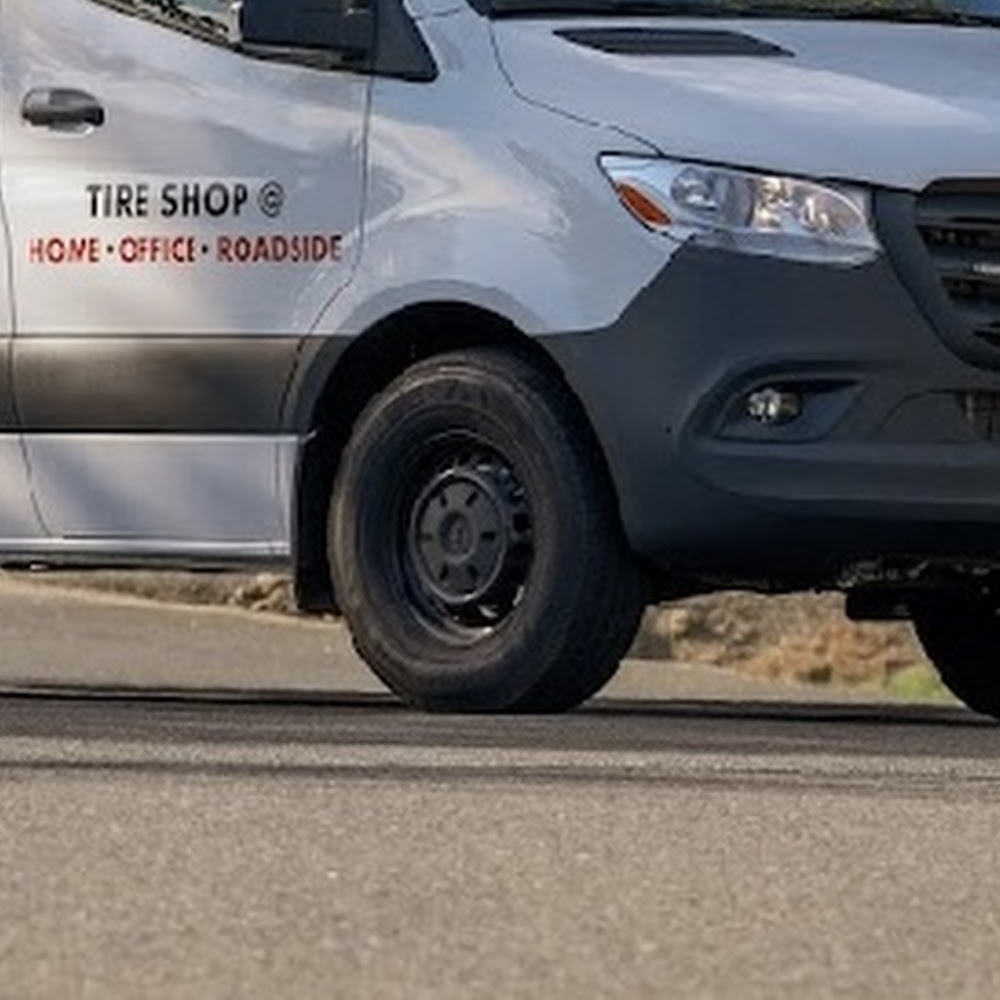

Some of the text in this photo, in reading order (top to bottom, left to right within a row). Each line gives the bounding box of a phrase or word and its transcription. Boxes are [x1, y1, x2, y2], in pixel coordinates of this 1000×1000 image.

[86, 184, 149, 217] TIRE
[160, 184, 249, 217] SHOP
[29, 234, 343, 263] HOME OFFICE ROADSIDE
